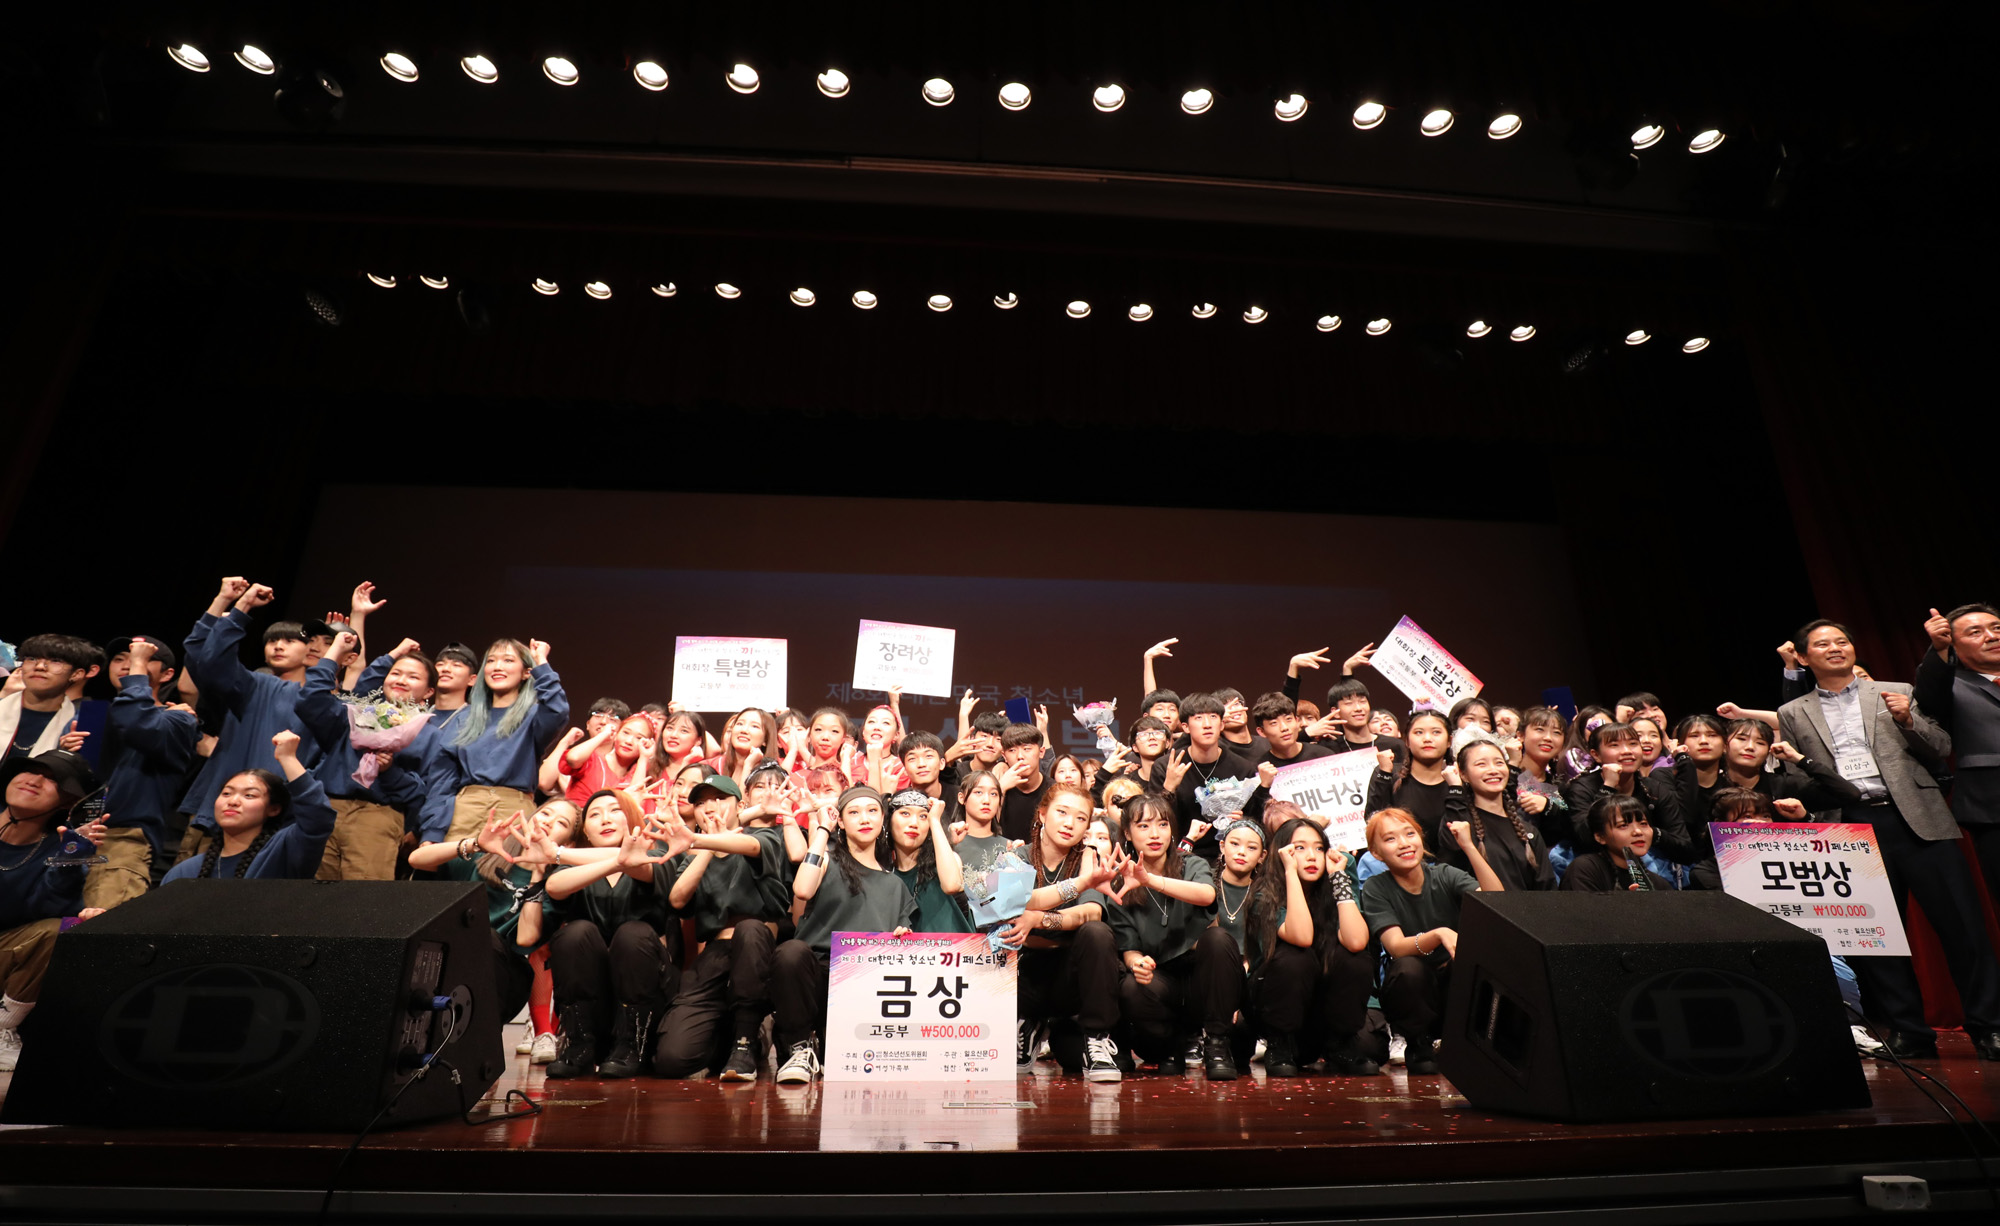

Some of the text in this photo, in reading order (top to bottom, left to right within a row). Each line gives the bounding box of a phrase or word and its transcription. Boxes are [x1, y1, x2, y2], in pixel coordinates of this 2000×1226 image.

[879, 642, 933, 665] 장려상
[681, 658, 771, 678] 대회장 특별상
[1395, 636, 1417, 658] 대회장
[1417, 655, 1461, 698] 특별상
[1399, 660, 1417, 677] 고등부
[1291, 779, 1364, 812] 매너상
[1748, 841, 1780, 852] 대한민국
[1783, 841, 1808, 852] 청소년
[1810, 840, 1831, 853] 끼
[1831, 841, 1871, 854] 페스티벌
[1760, 861, 1852, 898] 모범상
[1768, 904, 1867, 918] 고등부 ₩100,000
[868, 953, 904, 965] 대한민국
[909, 954, 936, 966] 청소년
[940, 952, 960, 967] 끼
[962, 952, 1008, 968] 페스티벌
[1487, 998, 1498, 1040] DYNACORD
[869, 1025, 980, 1039] 고등부 ₩500,000
[944, 1050, 988, 1059] 주관 일요신문
